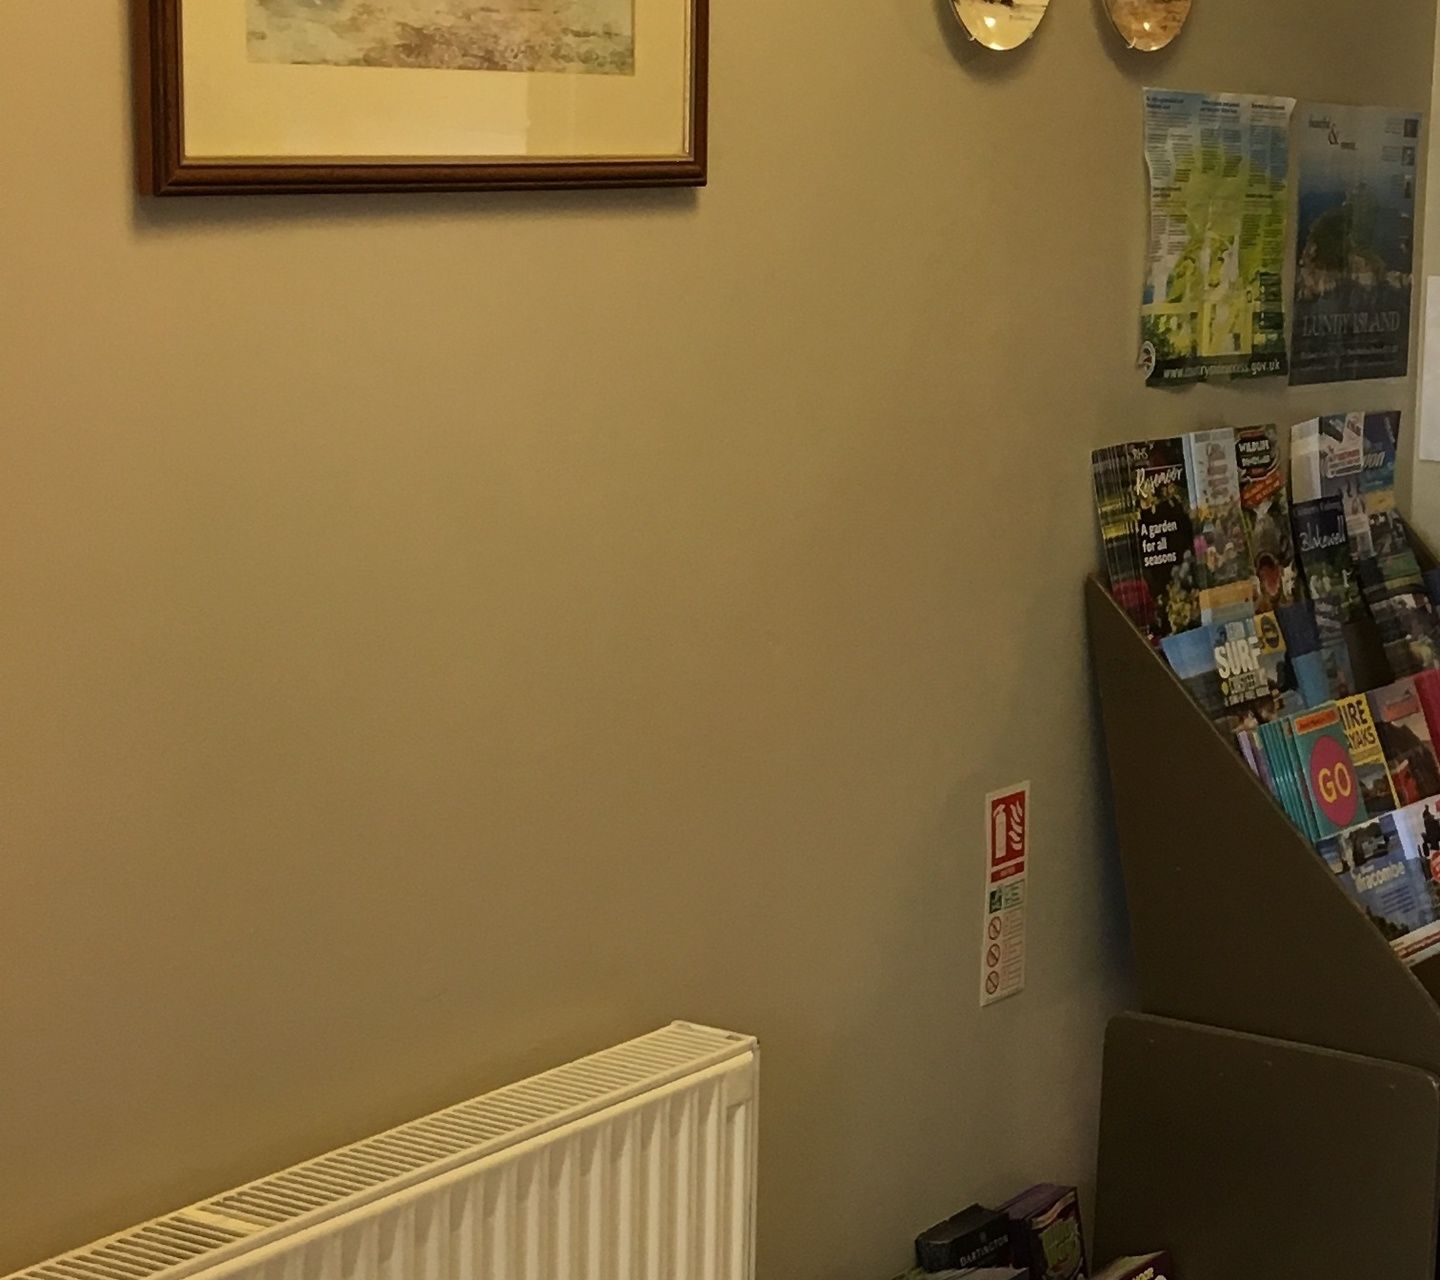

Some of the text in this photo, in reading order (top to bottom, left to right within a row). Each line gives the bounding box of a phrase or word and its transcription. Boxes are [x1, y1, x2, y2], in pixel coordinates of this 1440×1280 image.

[1141, 520, 1178, 538] A garden
[1142, 537, 1167, 553] for all
[1144, 552, 1177, 567] seasons
[1214, 636, 1261, 679] SURF
[1318, 762, 1351, 804] GO
